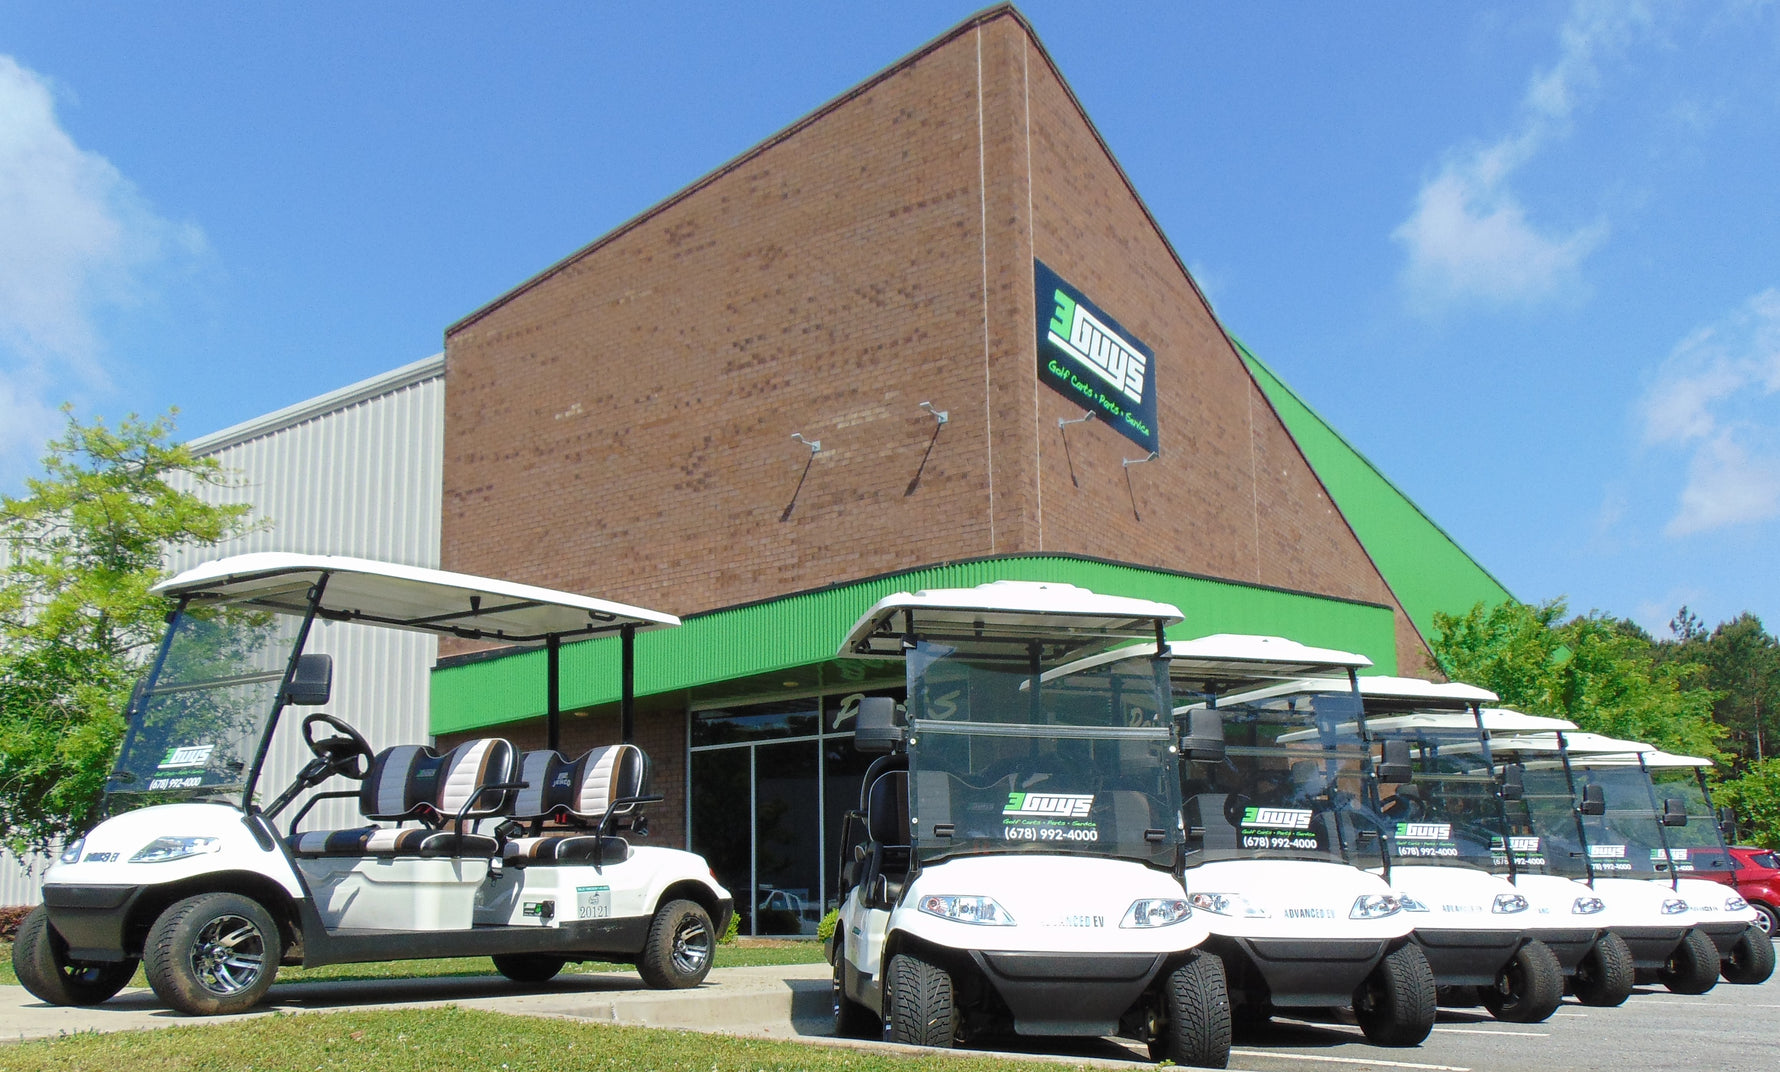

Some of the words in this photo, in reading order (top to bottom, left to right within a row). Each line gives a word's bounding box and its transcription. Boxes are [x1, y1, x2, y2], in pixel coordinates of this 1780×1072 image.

[1048, 360, 1071, 380] Golf
[1071, 375, 1093, 398] Carts
[1099, 394, 1121, 416] Parts
[1125, 412, 1150, 436] Service
[149, 778, 169, 790] (678)
[169, 776, 202, 788] 992-4000
[1005, 827, 1037, 841] (678)
[1040, 829, 1098, 841] 992-4000
[1243, 836, 1270, 848] (678)
[1272, 838, 1318, 849] 992-4000
[1398, 846, 1419, 856] (678)
[1420, 847, 1458, 856] 992-4000
[580, 905, 609, 918] 20121
[1093, 915, 1104, 928] EV
